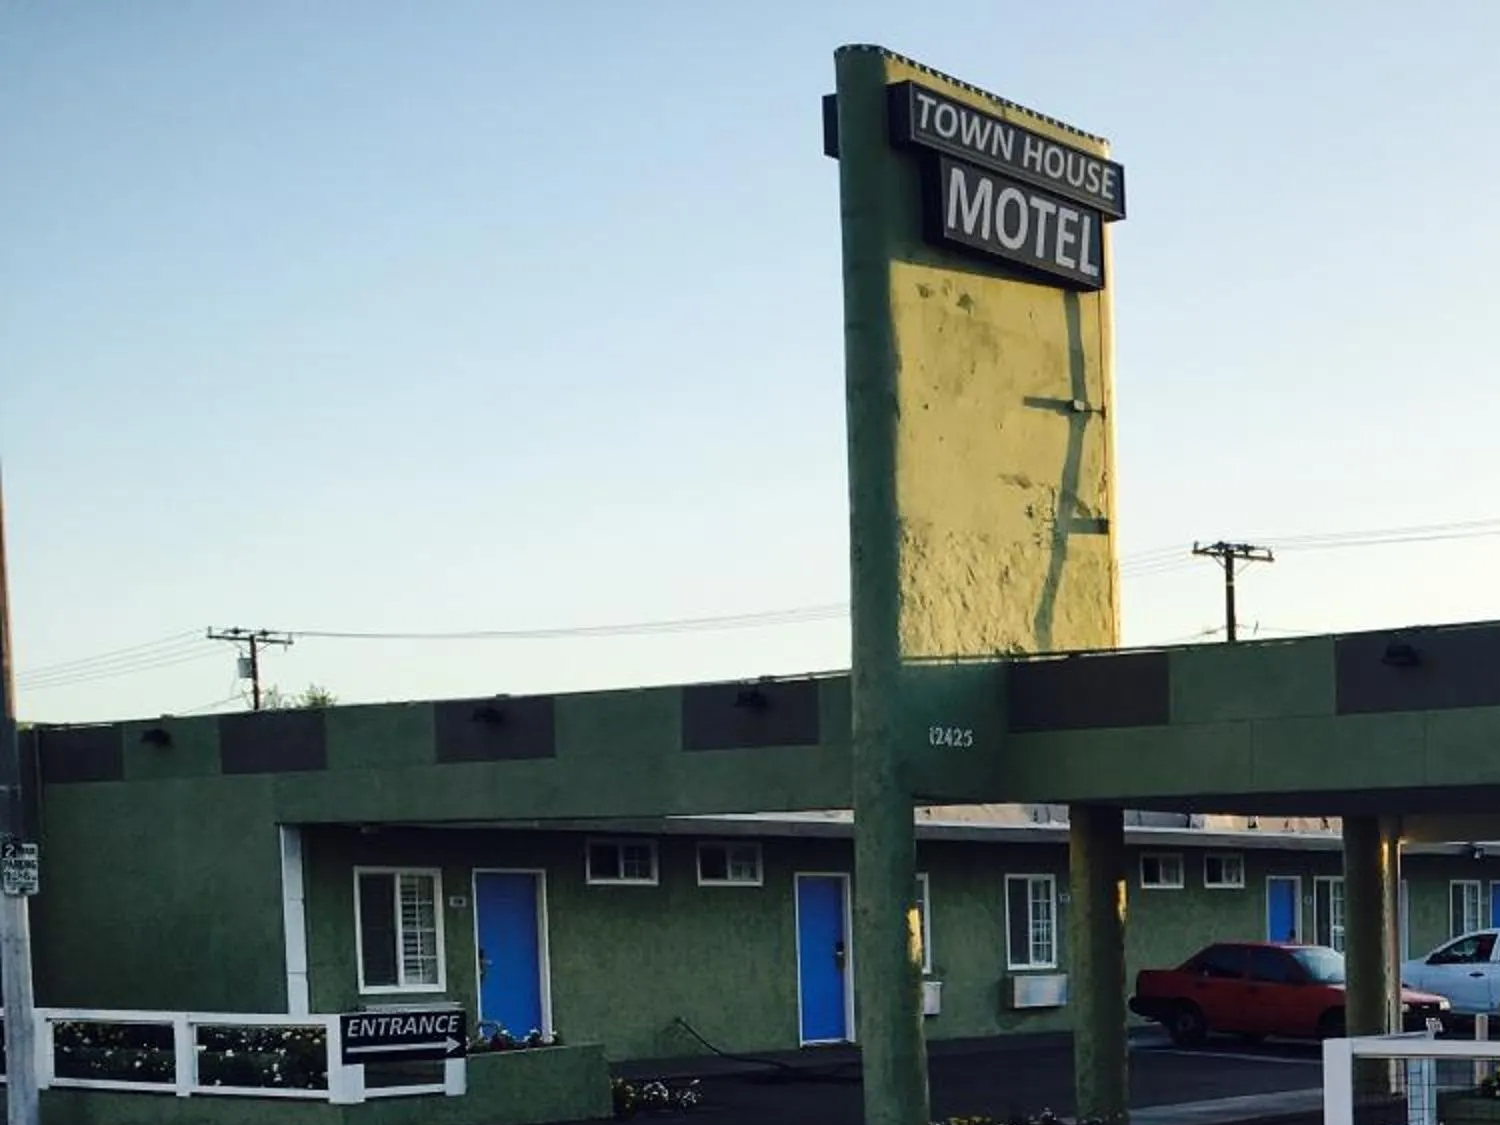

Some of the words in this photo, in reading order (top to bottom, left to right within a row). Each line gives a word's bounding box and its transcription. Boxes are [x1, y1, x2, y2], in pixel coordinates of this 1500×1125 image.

[917, 94, 1014, 161] TOWN
[1022, 136, 1117, 200] HOUSE
[946, 167, 1099, 277] MOTEL
[928, 727, 973, 748] 12425
[347, 1015, 460, 1038] ENTRANCE
